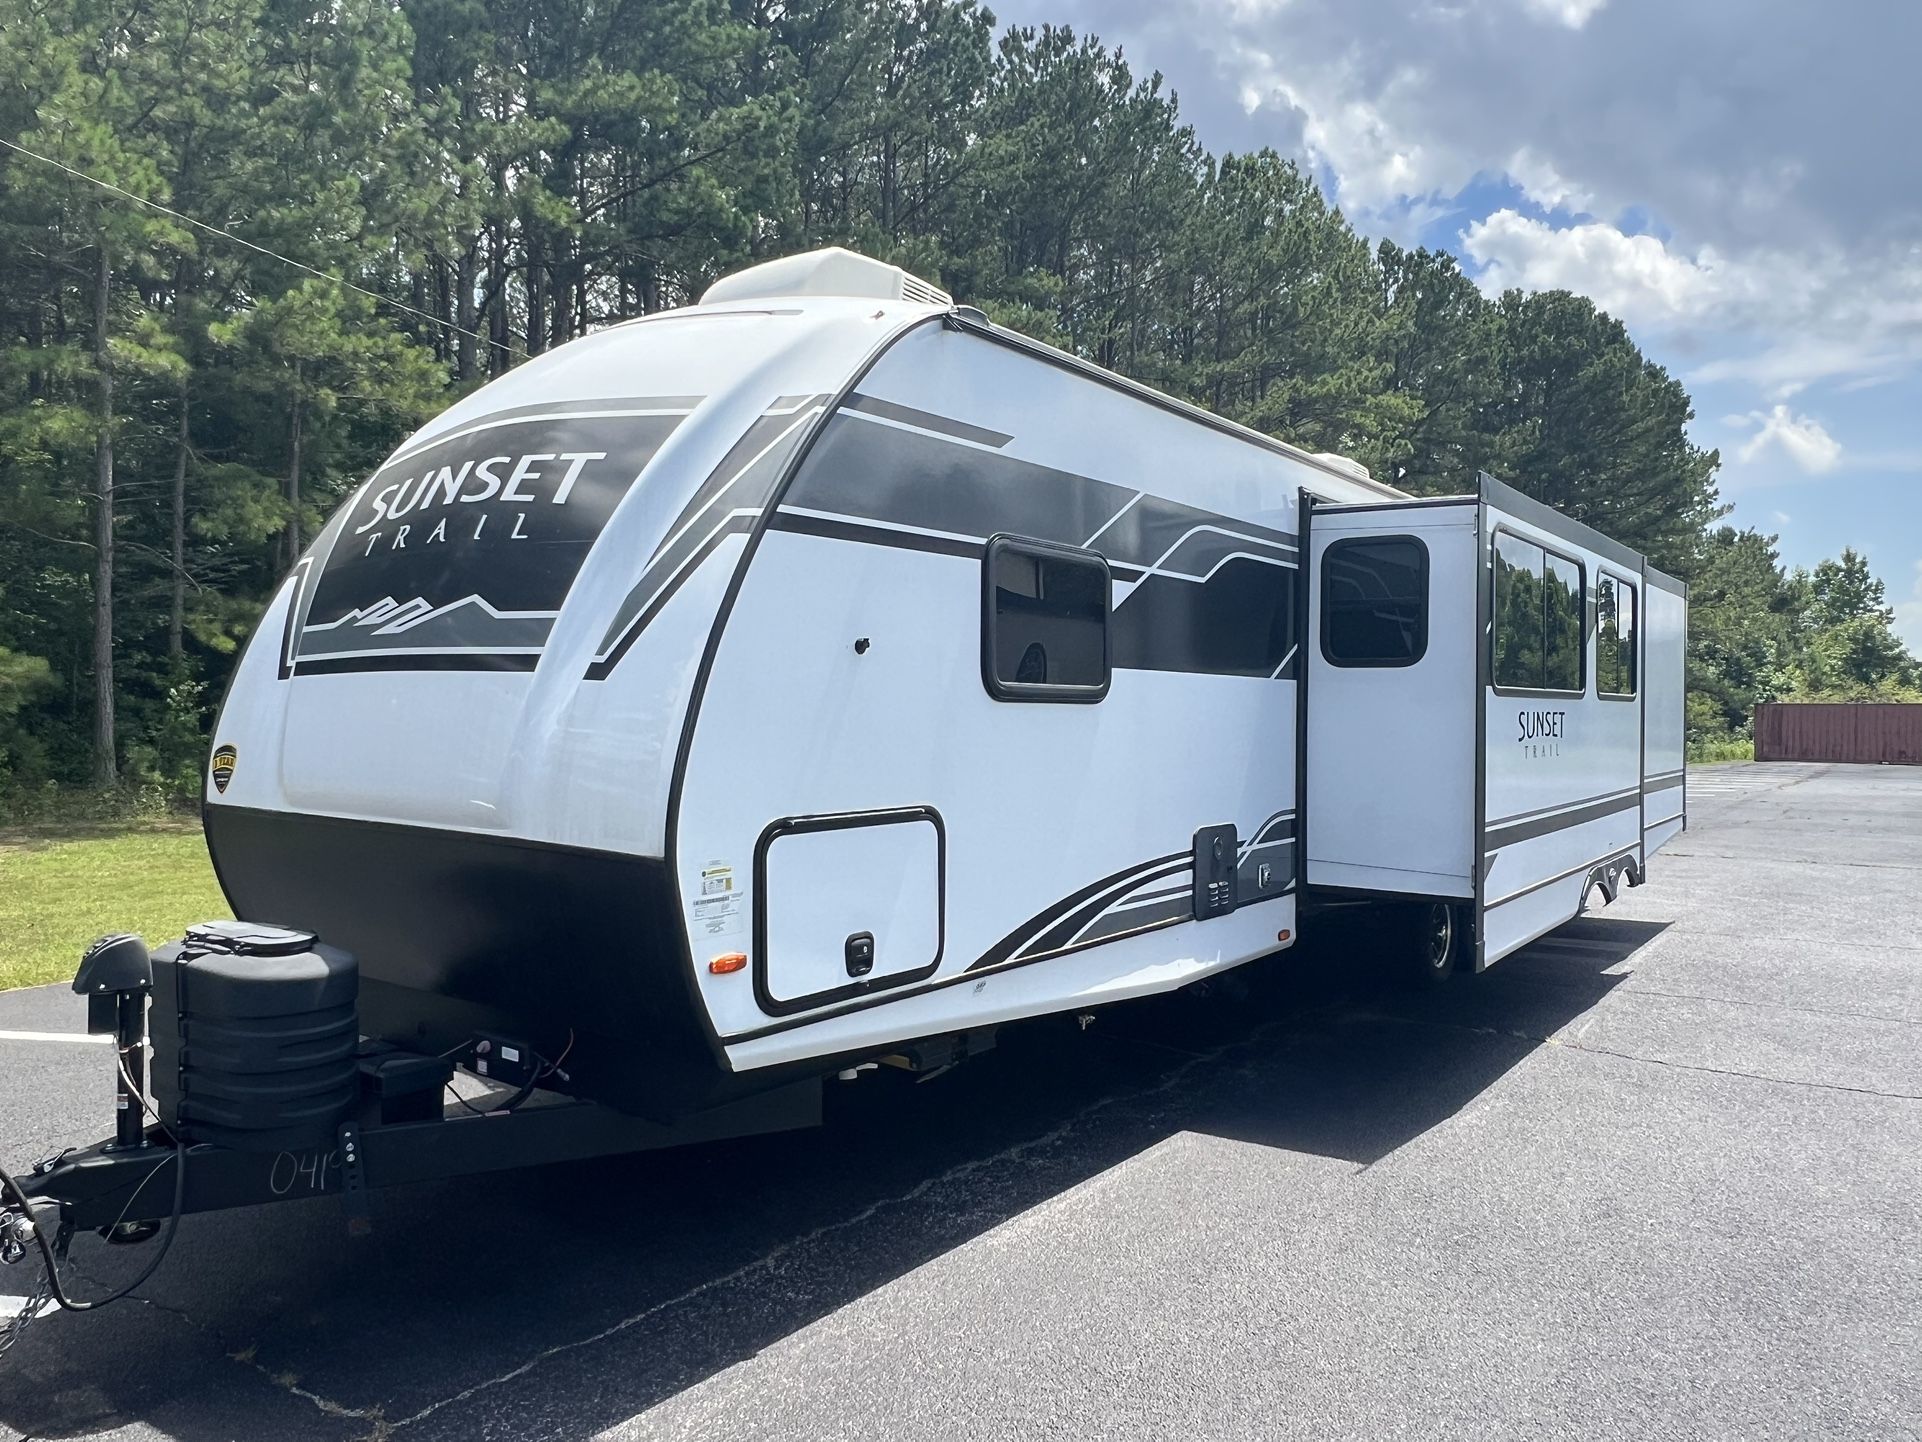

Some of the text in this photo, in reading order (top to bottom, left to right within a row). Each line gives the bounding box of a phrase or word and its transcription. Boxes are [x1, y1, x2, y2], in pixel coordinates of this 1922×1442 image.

[355, 452, 607, 535] SUNSET
[365, 513, 528, 557] TRAIL
[1518, 711, 1566, 743] SUNSET
[1524, 743, 1560, 760] TRAIL
